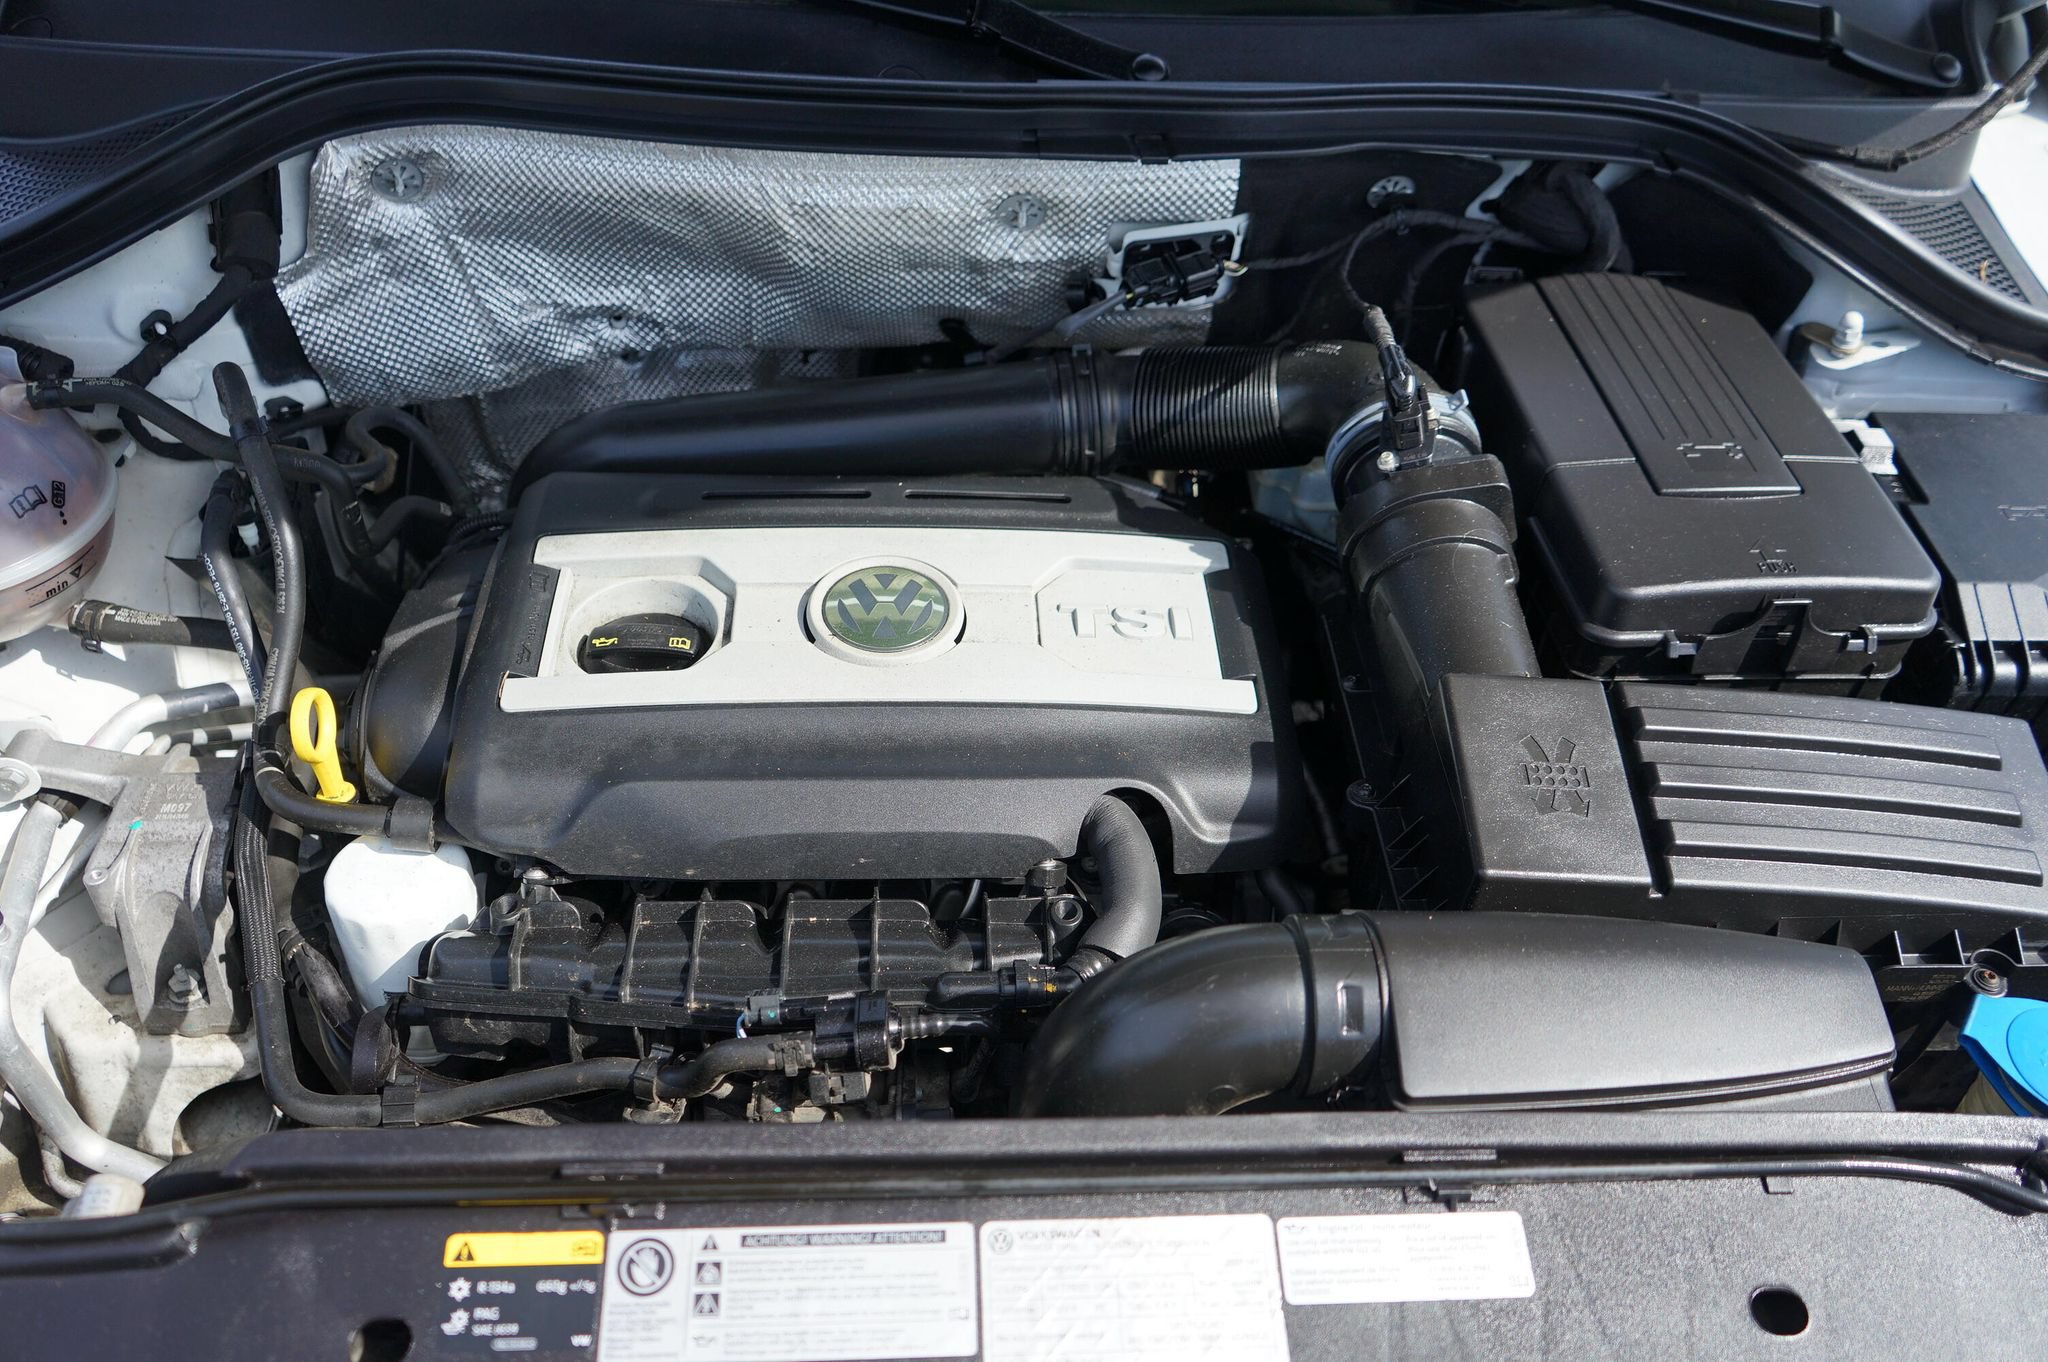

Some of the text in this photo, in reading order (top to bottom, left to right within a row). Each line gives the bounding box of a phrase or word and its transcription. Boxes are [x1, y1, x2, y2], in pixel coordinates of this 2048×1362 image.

[1757, 562, 1799, 574] PUSH
[46, 581, 69, 598] min
[1057, 601, 1195, 641] TSI
